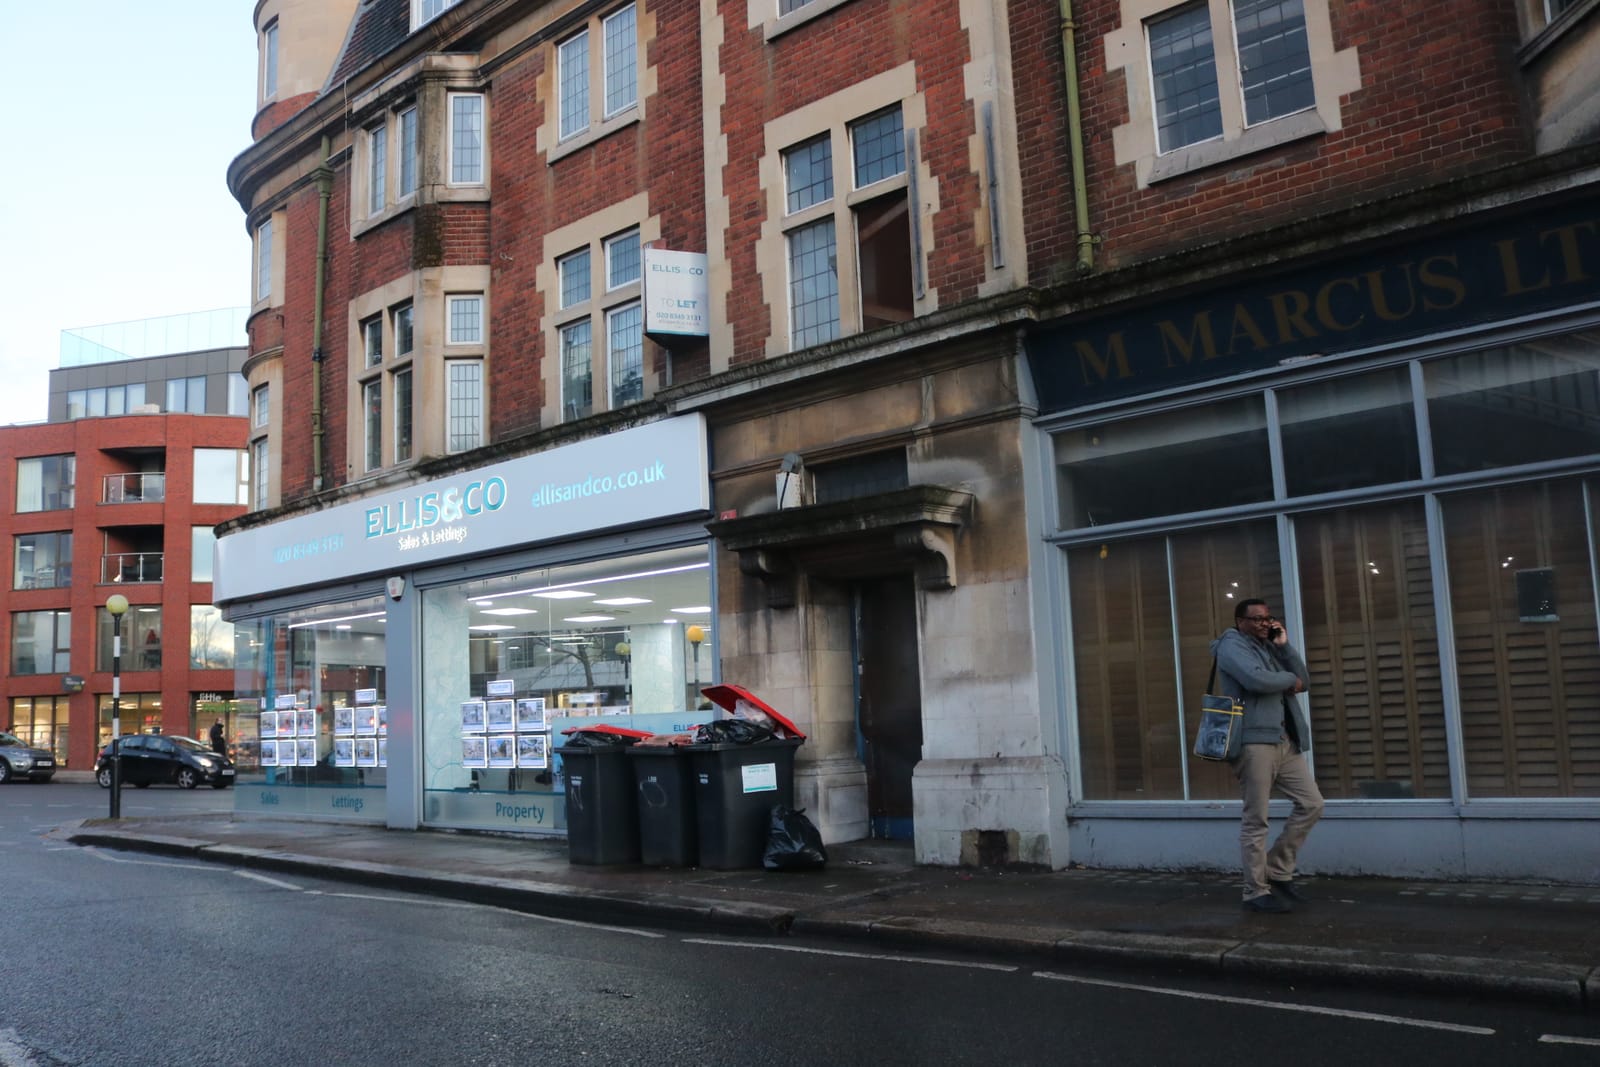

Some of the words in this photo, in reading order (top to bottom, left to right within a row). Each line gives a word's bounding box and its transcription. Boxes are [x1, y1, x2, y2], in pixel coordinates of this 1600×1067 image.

[662, 298, 674, 307] TO
[677, 300, 697, 309] LET
[1071, 330, 1136, 385] M
[1153, 253, 1467, 368] MARCUS
[531, 457, 667, 508] ellisandco.co.uk
[397, 535, 420, 551] Sales
[430, 525, 468, 544] Lettings
[199, 692, 222, 702] little
[260, 791, 279, 805] Sales
[331, 793, 364, 812] Lettings
[495, 801, 545, 824] Property
